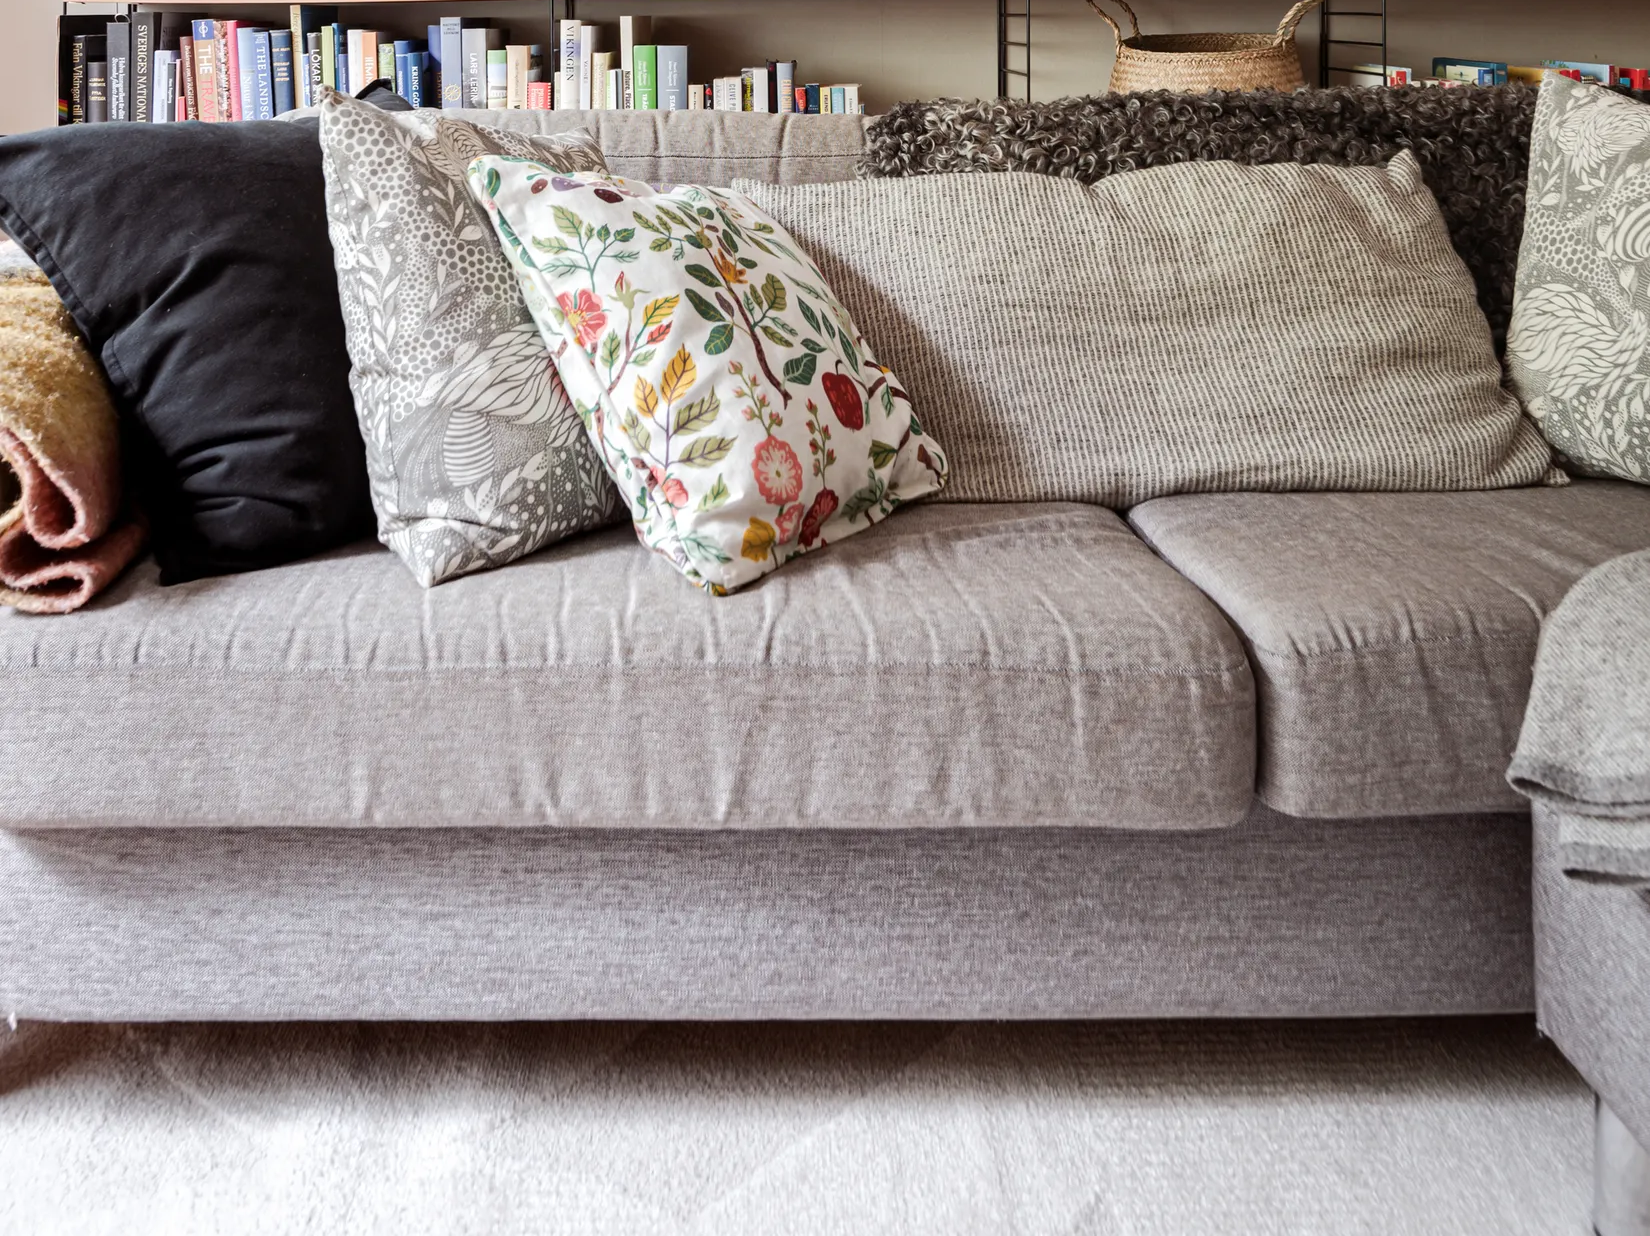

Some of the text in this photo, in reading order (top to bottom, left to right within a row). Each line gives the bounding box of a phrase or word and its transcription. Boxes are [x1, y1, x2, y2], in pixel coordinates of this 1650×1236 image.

[137, 25, 148, 74] SVERIGES
[199, 45, 212, 74] THE
[257, 47, 266, 70] THE
[311, 49, 321, 82] LÖKAR
[566, 26, 574, 81] VIKINGEN
[71, 43, 83, 116] Från Vikingar till
